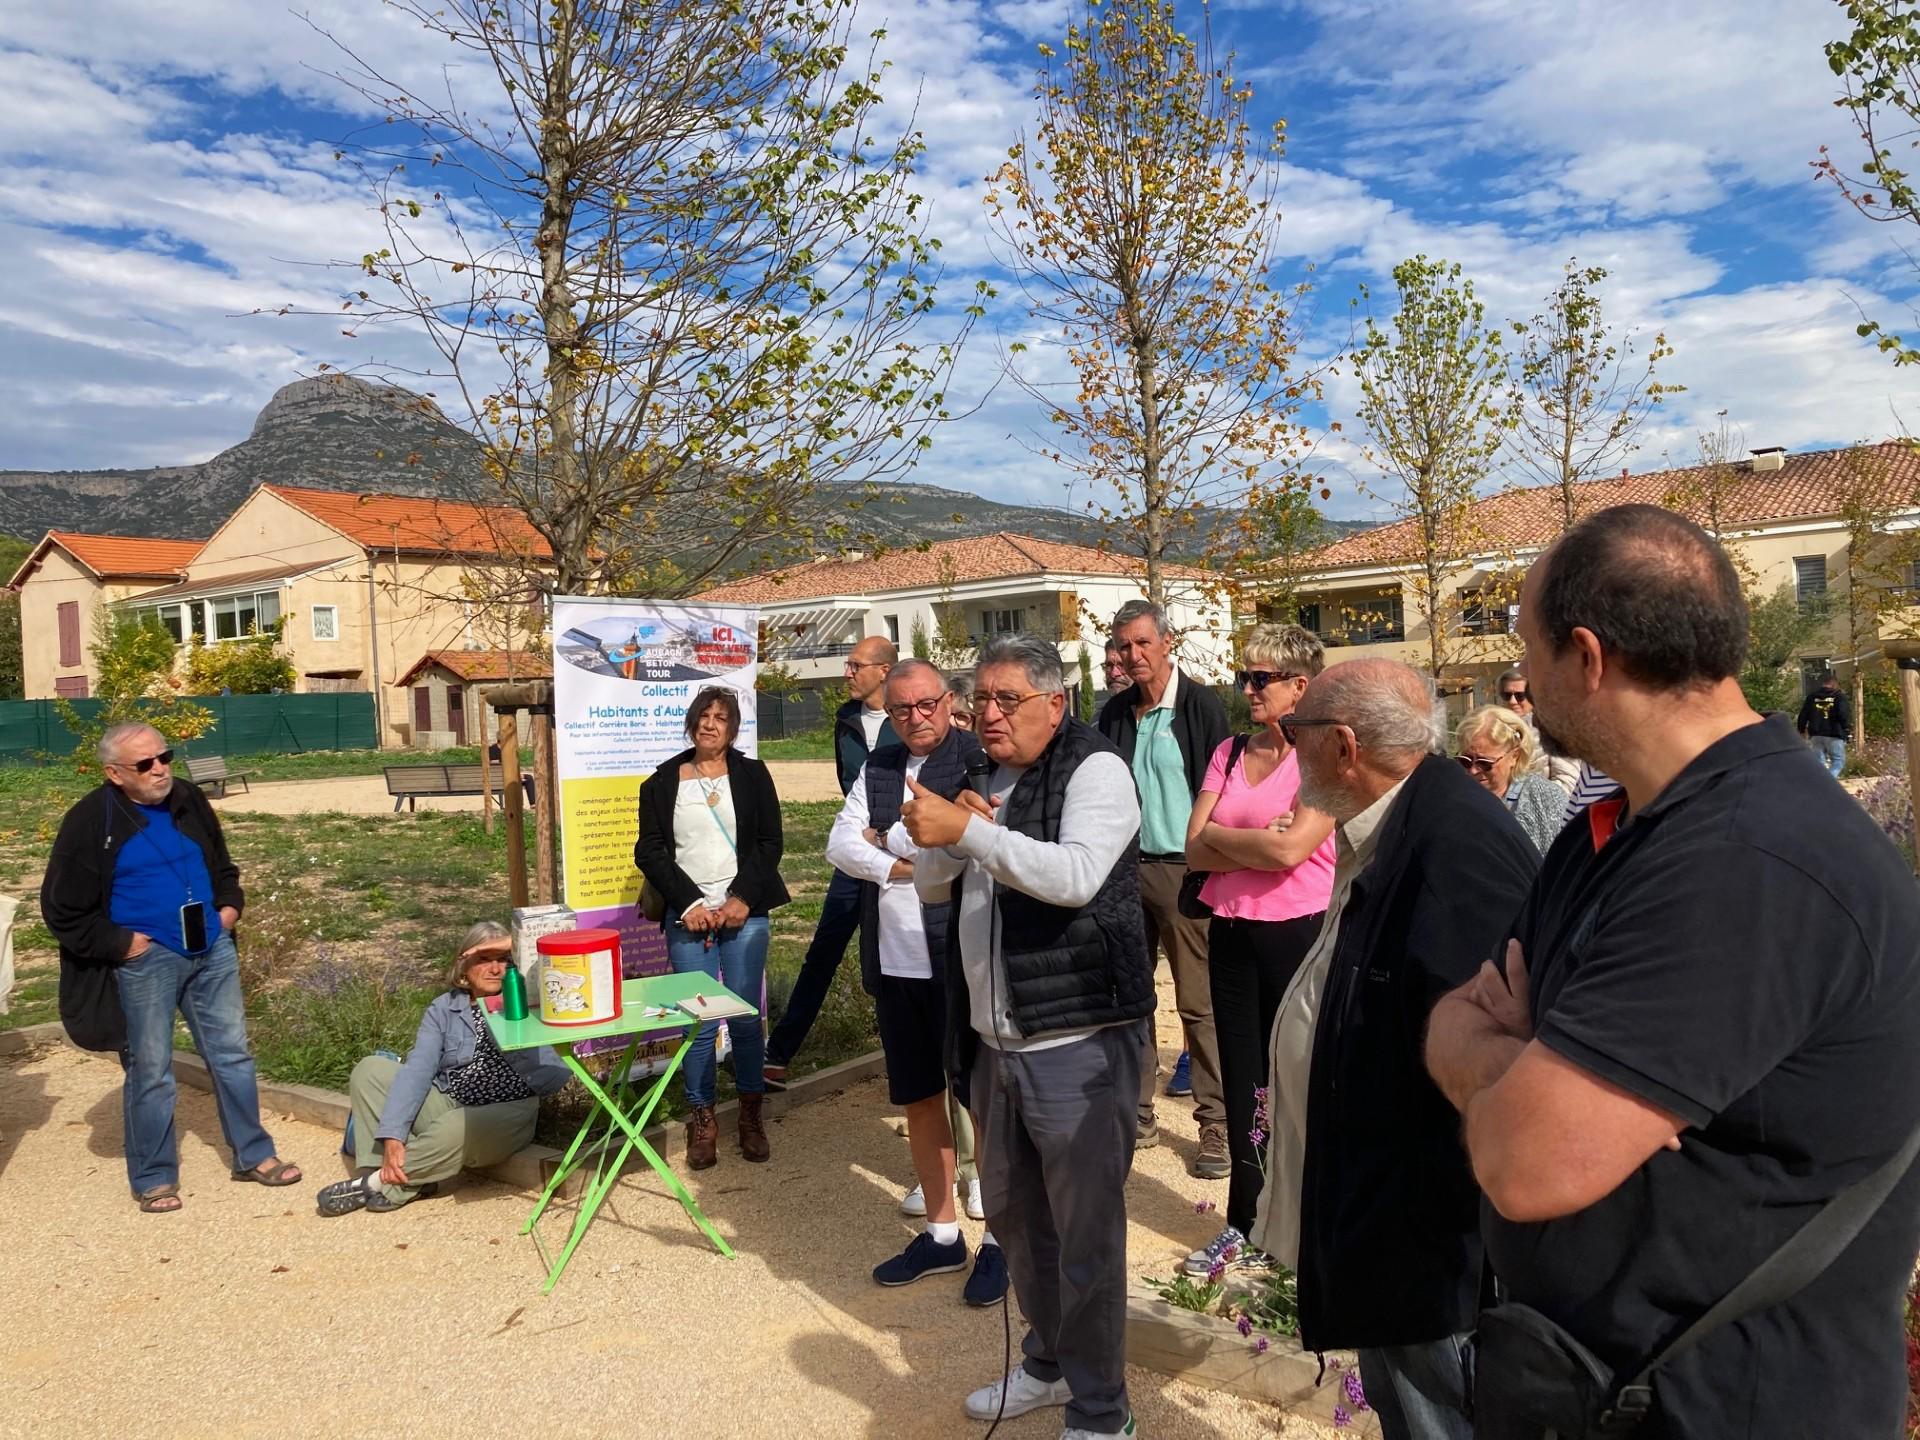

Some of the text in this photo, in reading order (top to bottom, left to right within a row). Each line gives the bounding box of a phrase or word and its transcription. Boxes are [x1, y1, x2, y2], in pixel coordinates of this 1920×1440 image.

[712, 628, 737, 643] ICI,
[646, 660, 675, 668] BETON
[646, 670, 671, 678] TOUR
[642, 685, 689, 697] Collectif
[589, 705, 649, 718] Habitants
[564, 722, 596, 730] Collectif
[599, 720, 628, 729] Carrière
[576, 809, 588, 817] des
[590, 808, 611, 817] enjeux
[588, 865, 614, 875] politique
[579, 878, 591, 886] des
[593, 878, 613, 886] usages
[580, 890, 594, 898] tout
